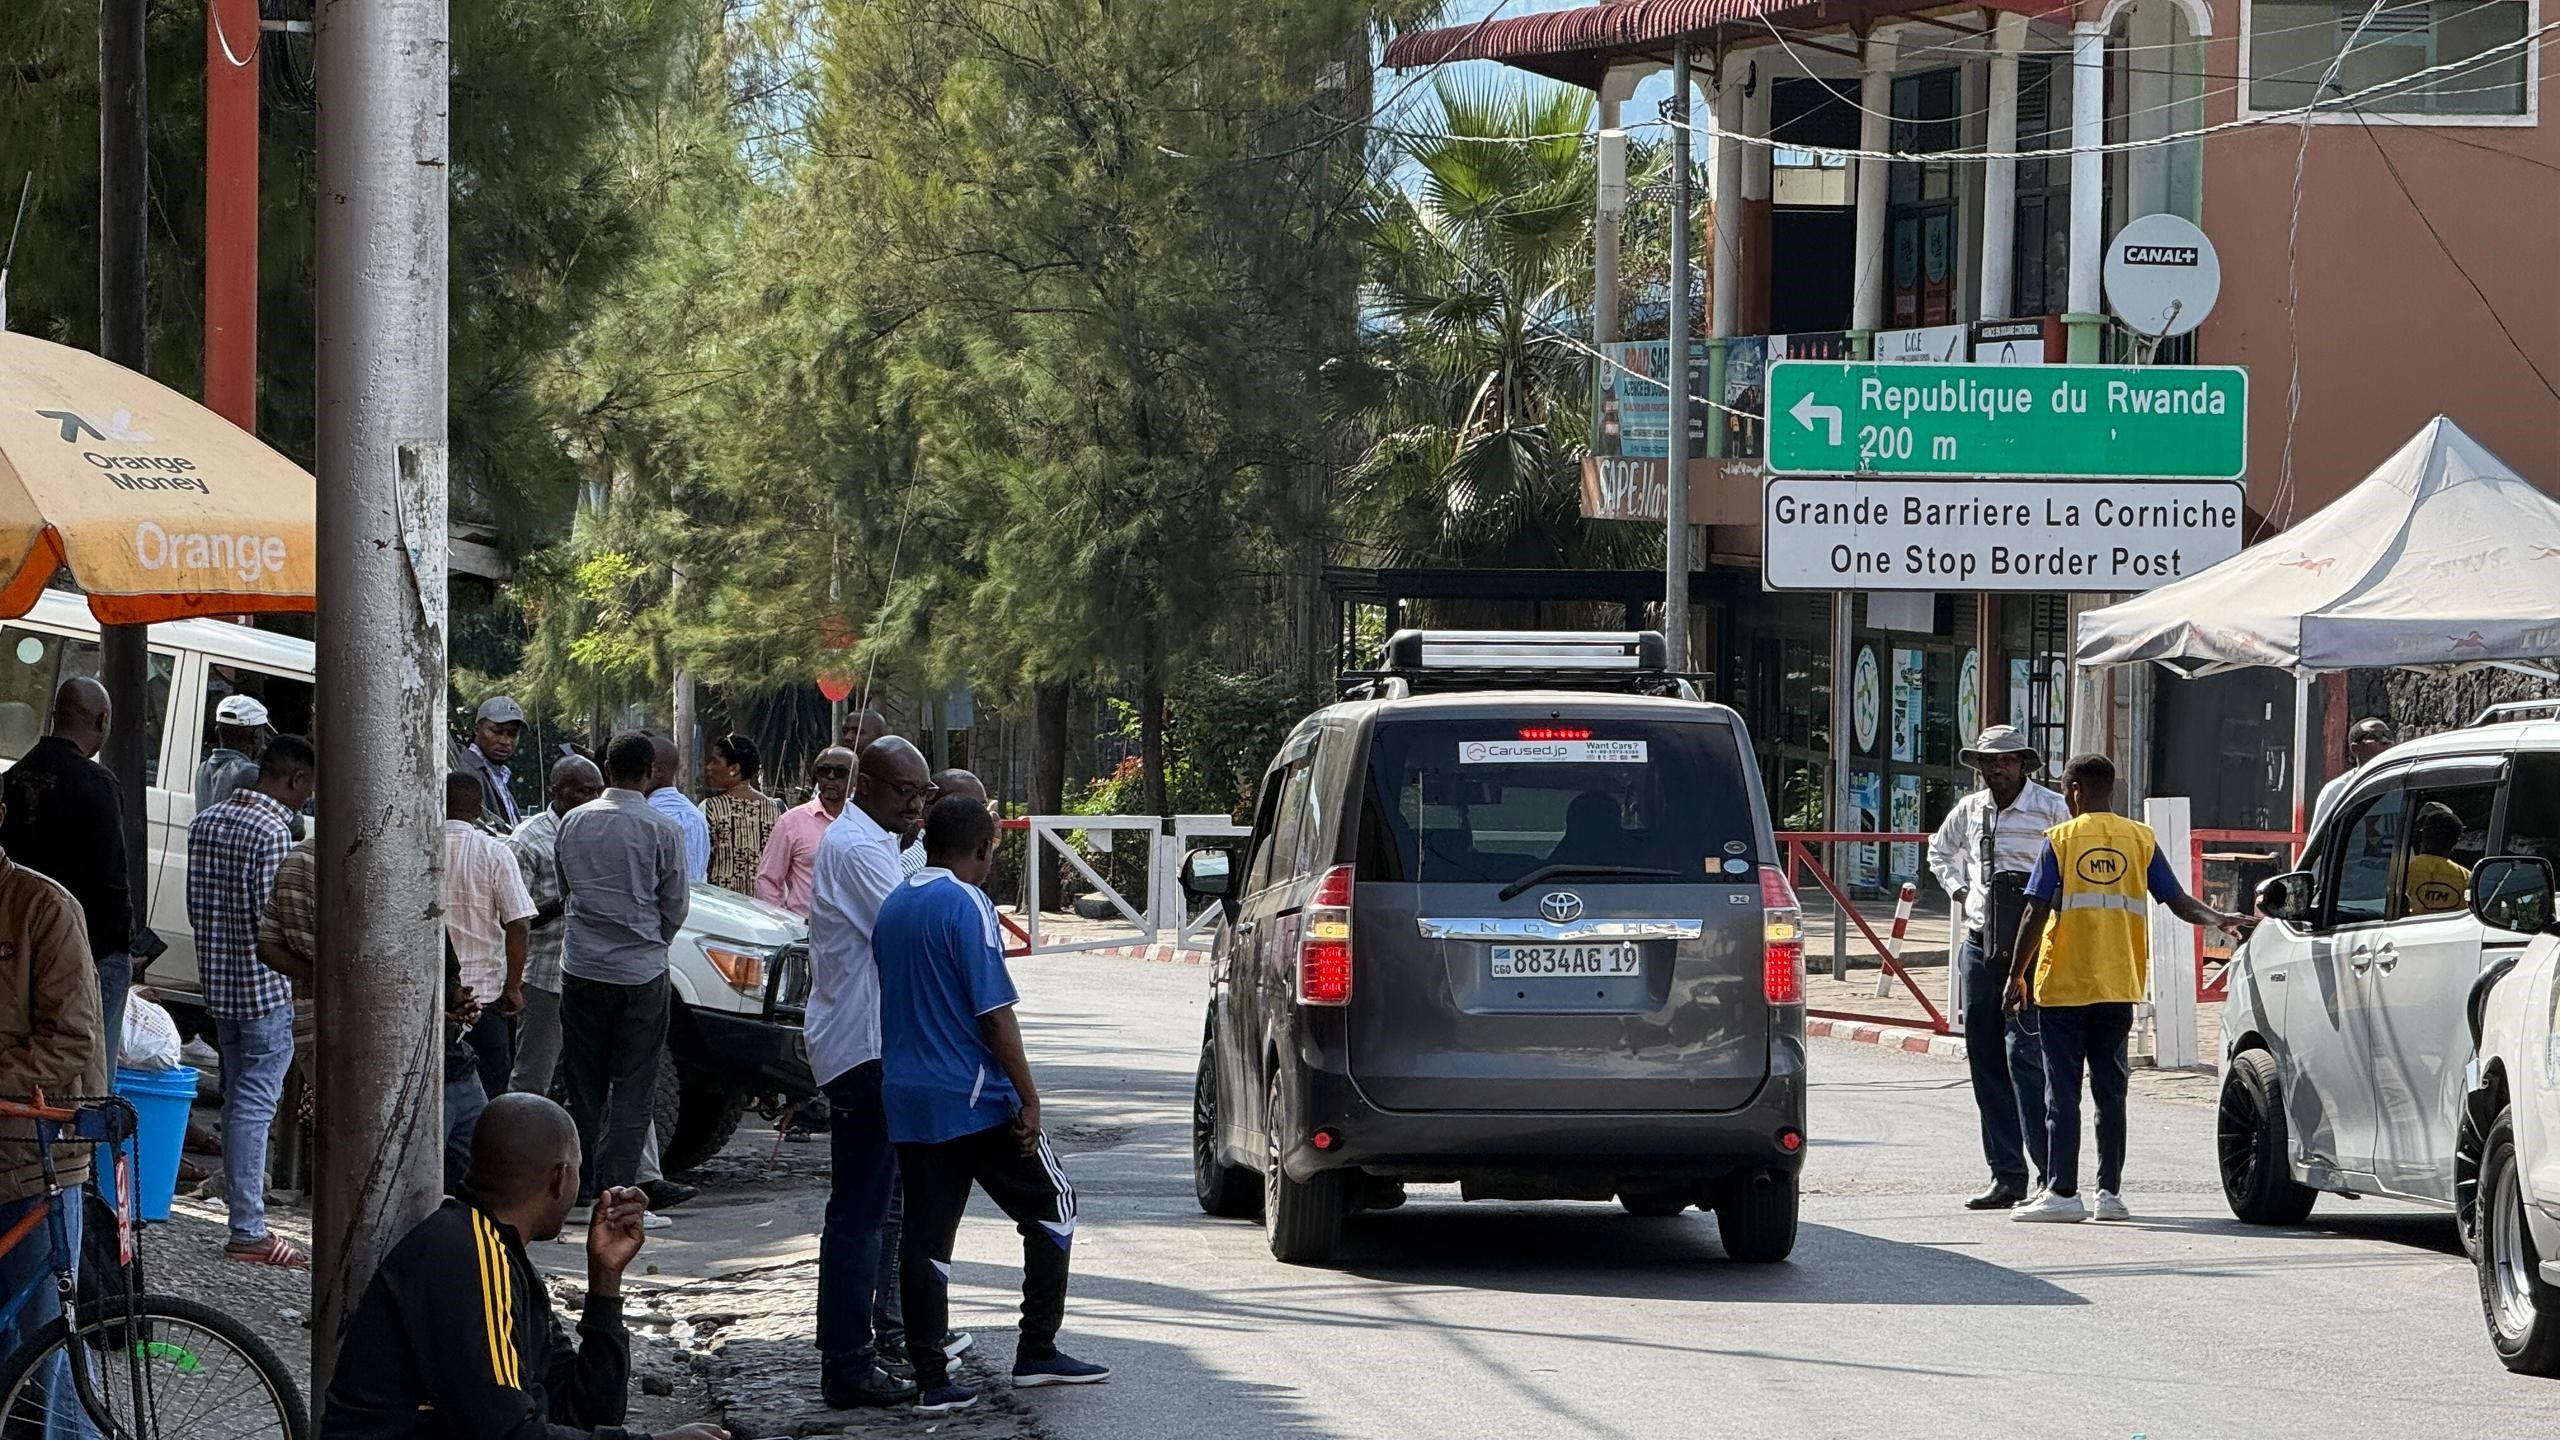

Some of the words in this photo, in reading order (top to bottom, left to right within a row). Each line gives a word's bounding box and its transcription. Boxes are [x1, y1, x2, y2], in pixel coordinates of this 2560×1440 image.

[2126, 247, 2196, 263] CANAL+
[1861, 379, 2032, 421] Republique
[2051, 380, 2087, 413] du
[2107, 382, 2225, 415] Rwanda
[1860, 427, 1913, 460] 200
[1932, 436, 1957, 461] m
[83, 450, 196, 473] Orange
[104, 472, 210, 494] Money
[1775, 495, 1888, 526] Grande
[1903, 496, 2031, 527] Barriere
[2046, 498, 2080, 527] La
[2094, 497, 2236, 528] Corniche
[135, 521, 287, 582] Orange
[1830, 544, 1891, 574] One
[1905, 544, 1976, 582] Stop
[1991, 546, 2098, 576] Border
[2112, 547, 2182, 576] Post
[1488, 745, 1568, 757] Carused.jp
[1586, 742, 1610, 750] Want
[1611, 742, 1638, 750] Cars?
[2090, 859, 2116, 873] MTN
[1514, 948, 1601, 975] 8834AG
[1609, 949, 1638, 973] 19
